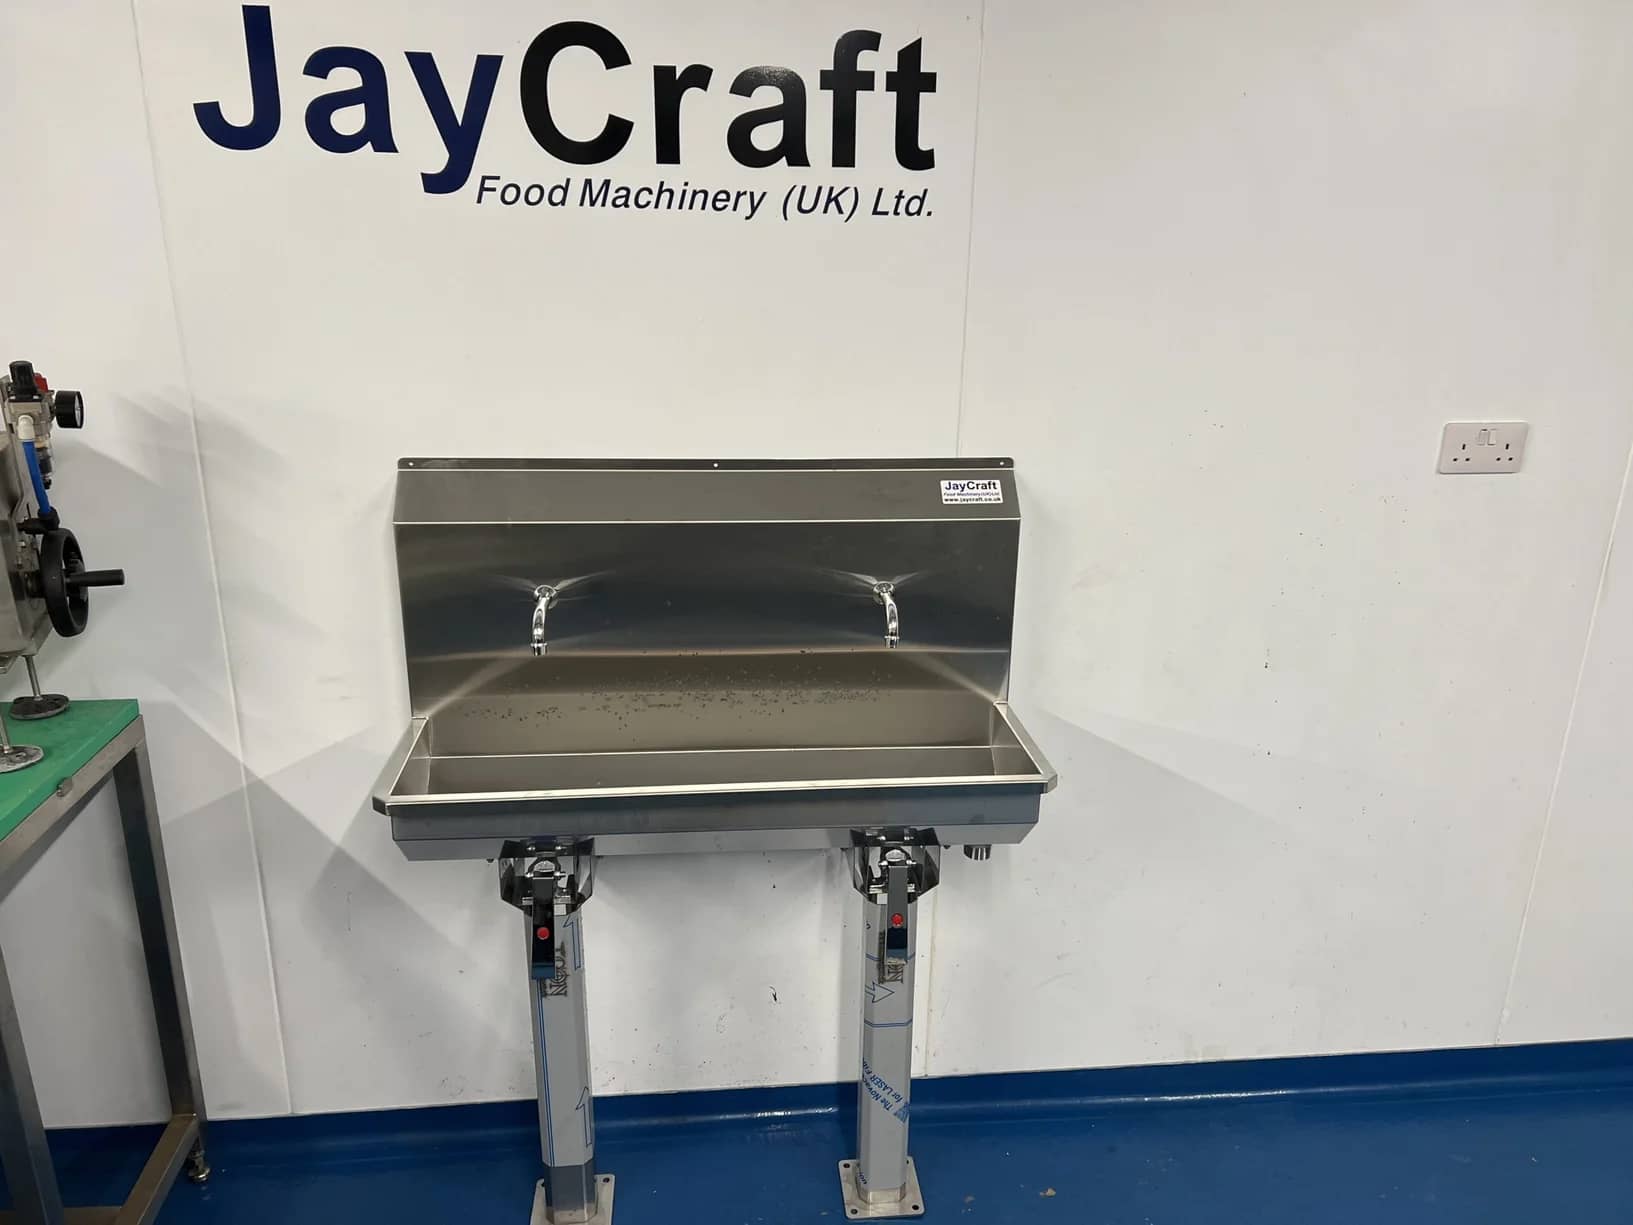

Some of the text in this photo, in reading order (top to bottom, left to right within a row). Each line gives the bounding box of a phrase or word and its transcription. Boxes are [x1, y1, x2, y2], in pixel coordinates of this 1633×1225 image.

[192, 4, 937, 195] JayCraft
[476, 176, 933, 223] Food Machinery (UK) Ltd.
[945, 481, 997, 492] JayCraft
[870, 1074, 893, 1095] LASER
